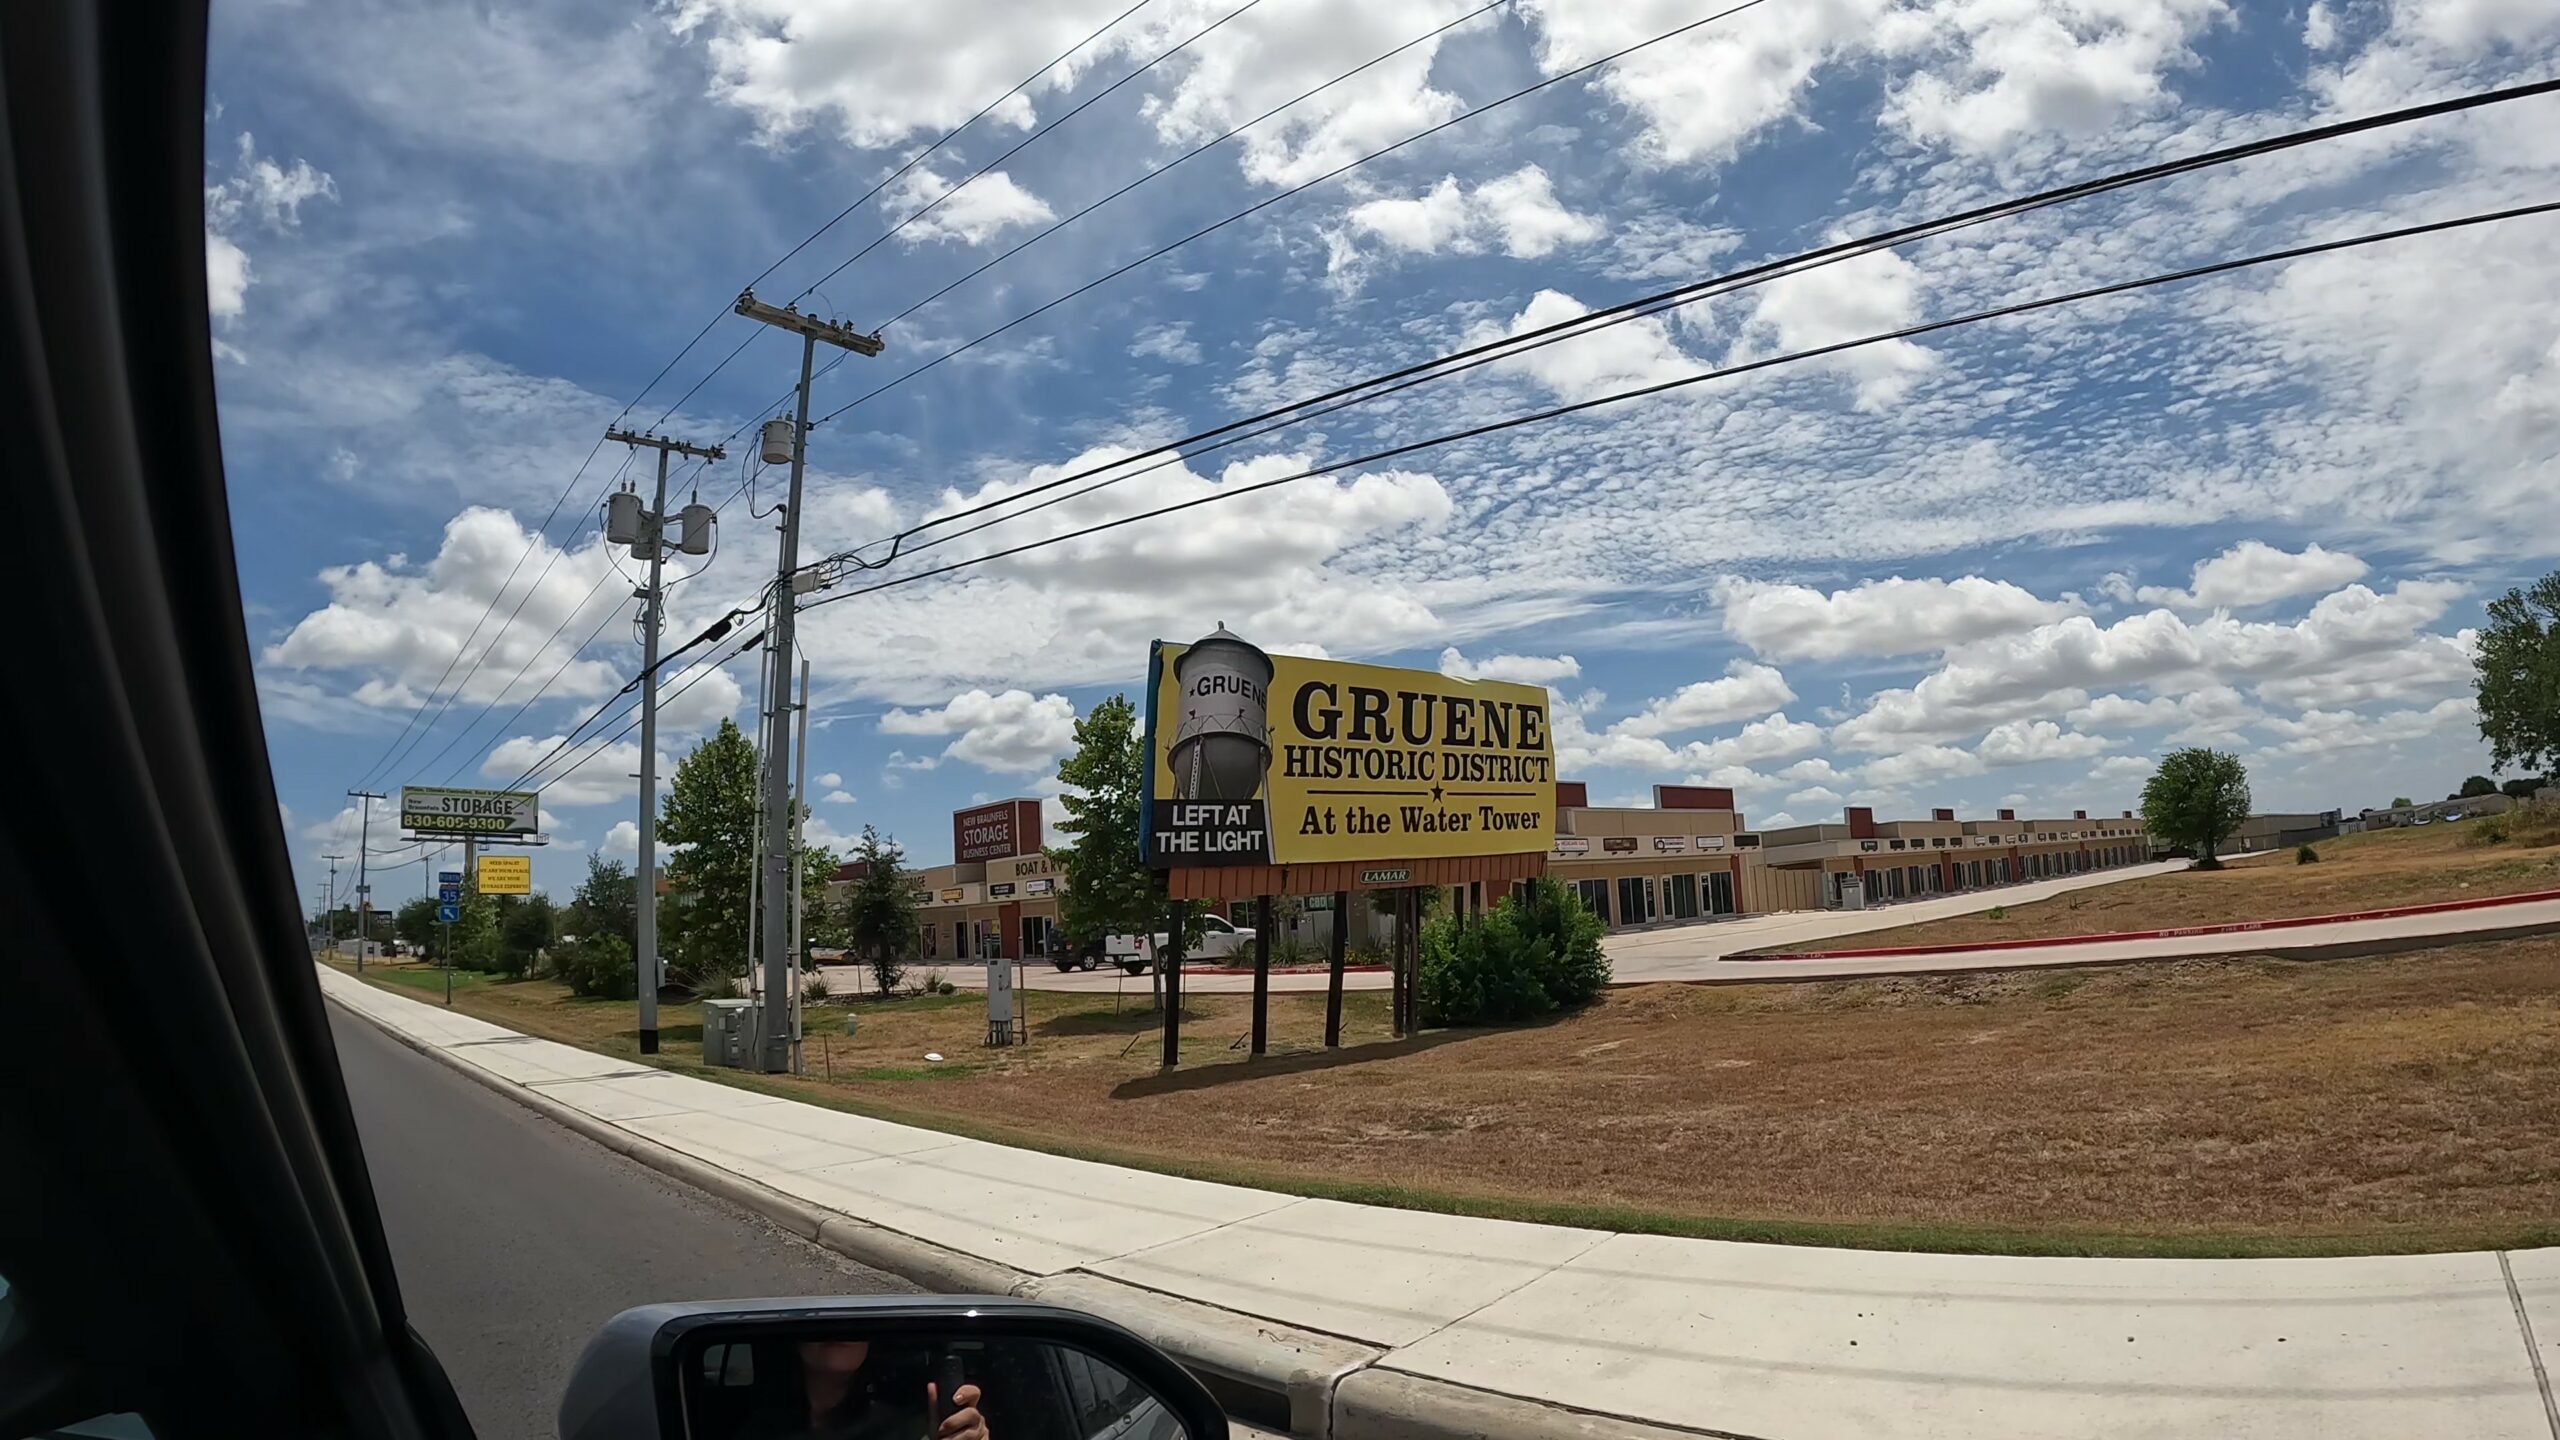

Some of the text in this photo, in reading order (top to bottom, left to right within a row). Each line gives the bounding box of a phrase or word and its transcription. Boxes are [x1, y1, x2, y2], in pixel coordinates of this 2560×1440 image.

[1197, 675, 1266, 712] GRUENE
[1292, 680, 1545, 750] GRUENE
[1283, 744, 1549, 783] HISTORIC DISTRICT
[442, 797, 513, 815] STORAGE
[1172, 805, 1251, 826] LEFT AT
[963, 810, 1008, 827] NEW BRAUNFELS
[1299, 805, 1541, 835] At the Water Tower
[963, 823, 1008, 846] STORAGE
[1156, 830, 1264, 853] THE LIGHT
[963, 843, 1011, 859] BUSINESS CENTER
[1015, 861, 1039, 876] BOAT
[1041, 860, 1048, 874] &
[1364, 871, 1406, 881] LAMAR
[442, 891, 457, 902] 35
